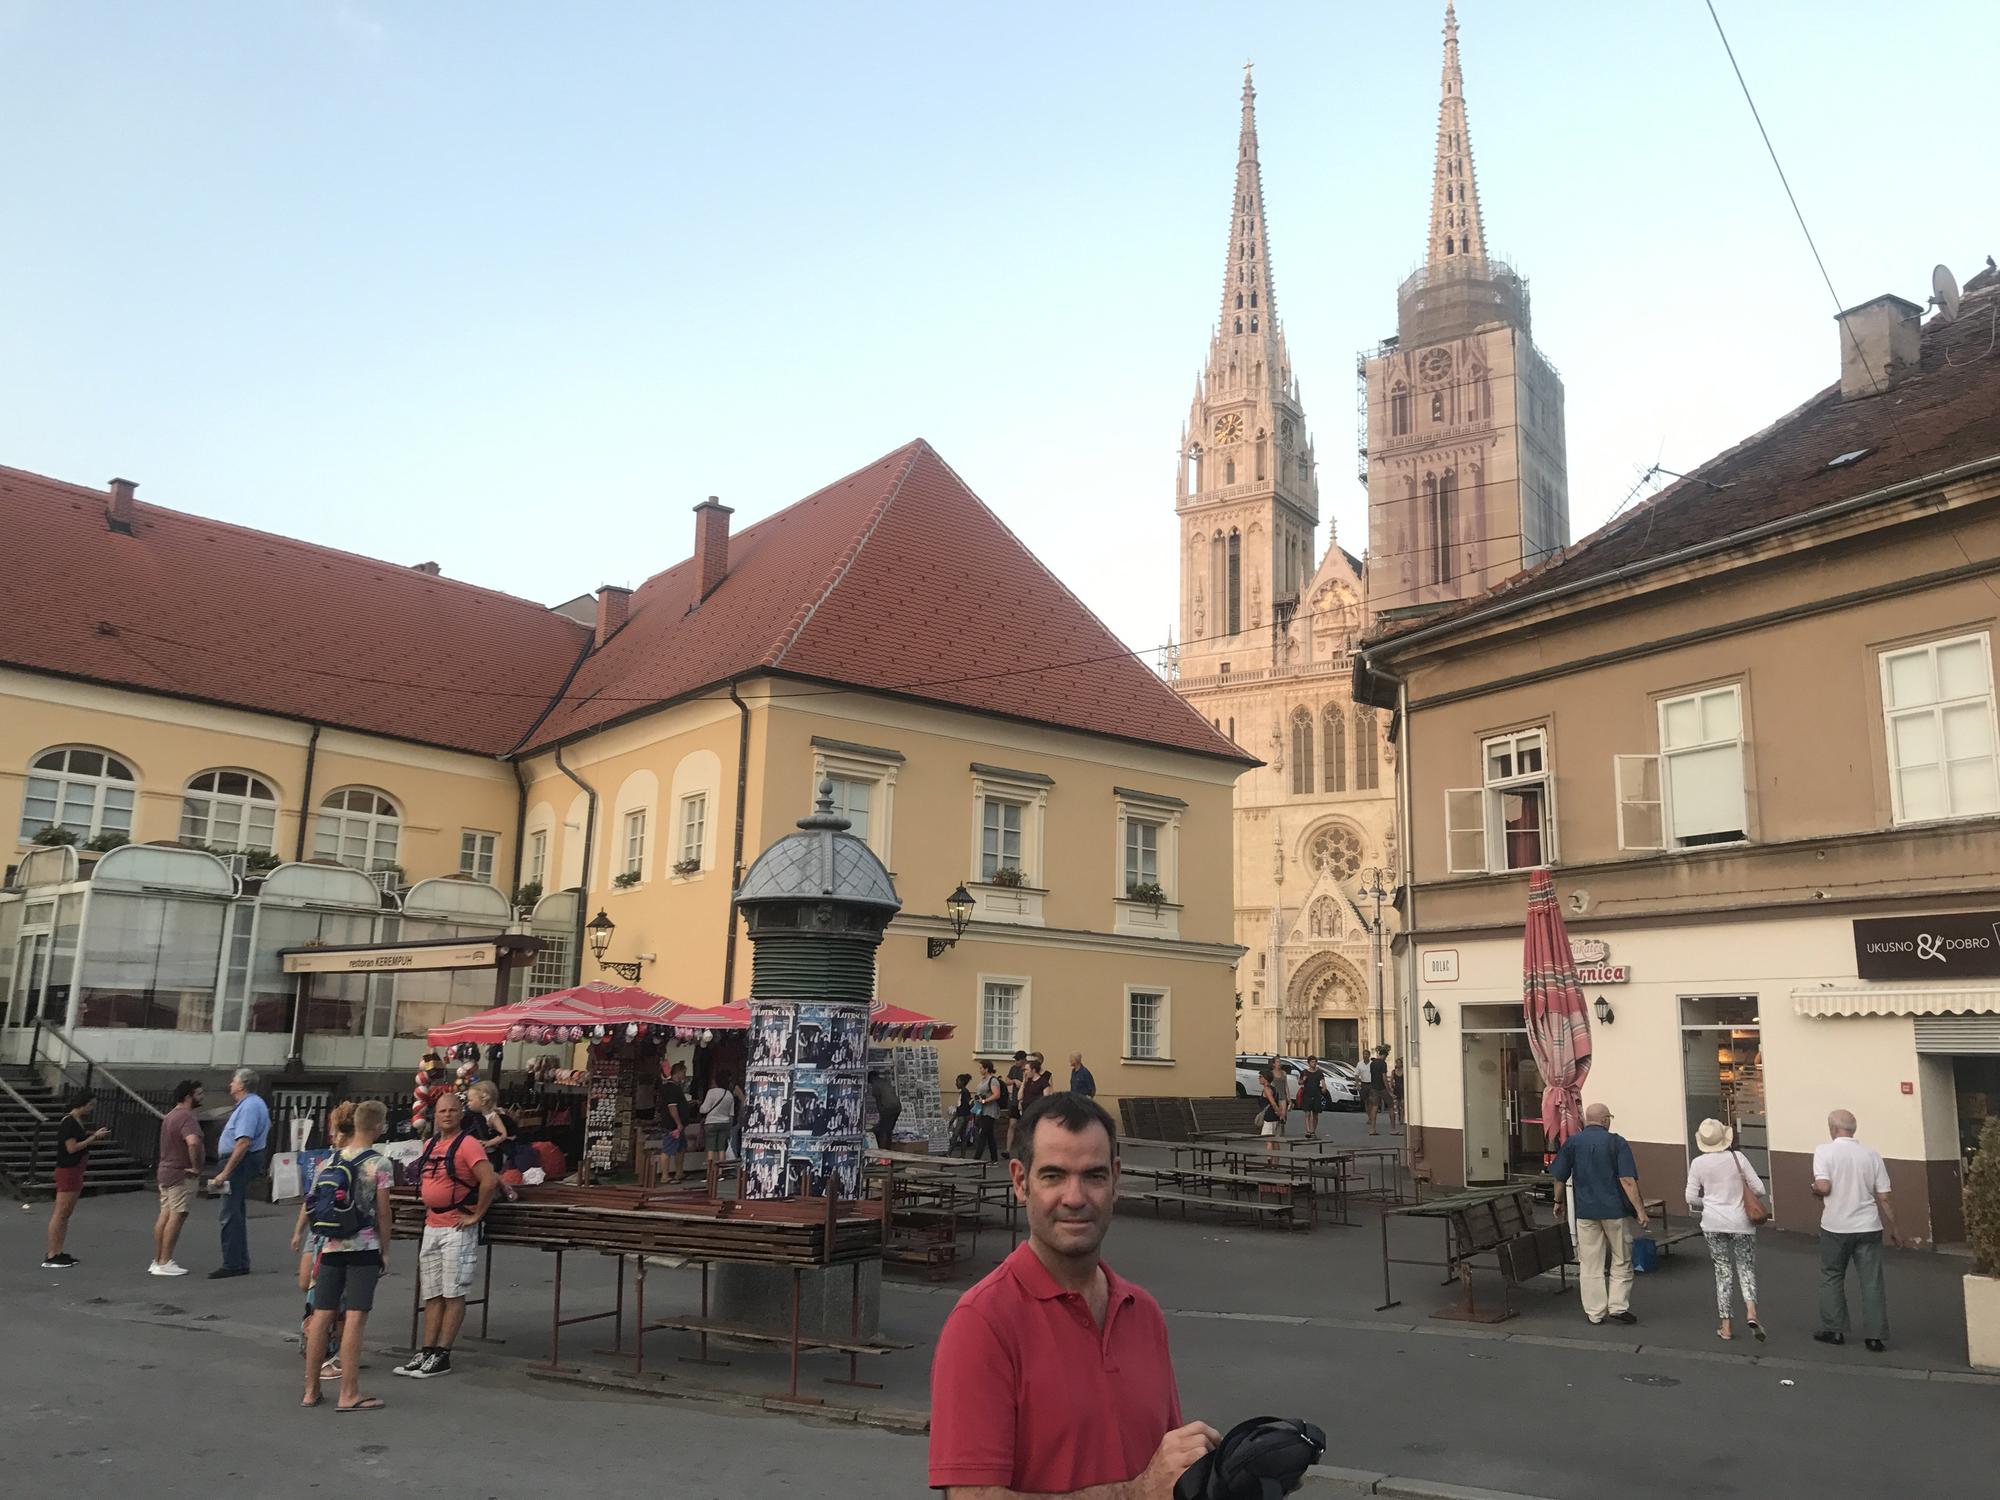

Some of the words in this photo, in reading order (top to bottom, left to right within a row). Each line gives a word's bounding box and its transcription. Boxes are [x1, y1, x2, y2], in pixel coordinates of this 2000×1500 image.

[1866, 941, 1914, 954] UKUSNO
[1945, 937, 1990, 950] DOBRO
[375, 956, 413, 967] KEREMPUH
[1578, 962, 1625, 981] rnica
